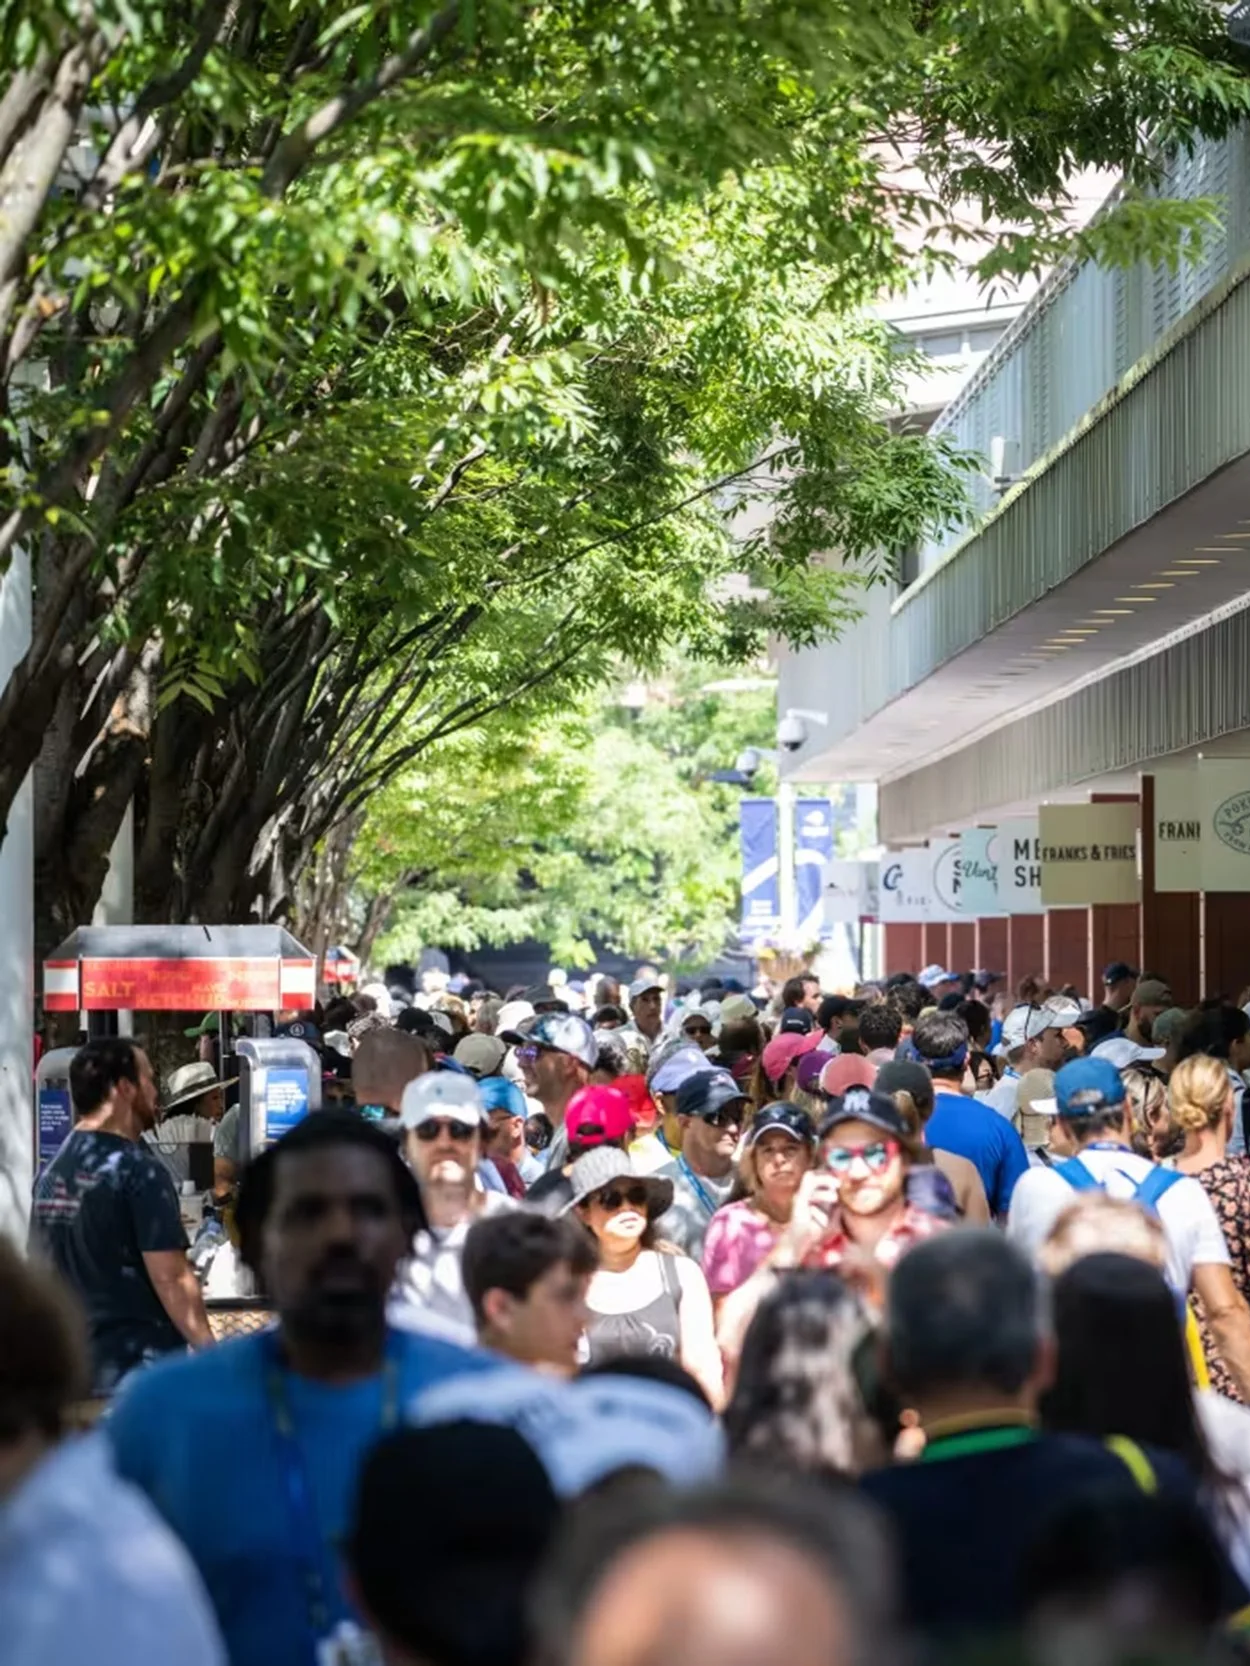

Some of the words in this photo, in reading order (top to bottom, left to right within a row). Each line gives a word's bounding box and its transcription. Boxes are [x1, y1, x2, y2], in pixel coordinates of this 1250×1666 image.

[1043, 846, 1088, 863] FRANKS
[1090, 843, 1101, 861] &
[1104, 844, 1136, 861] FRIES
[84, 981, 135, 997] SALT
